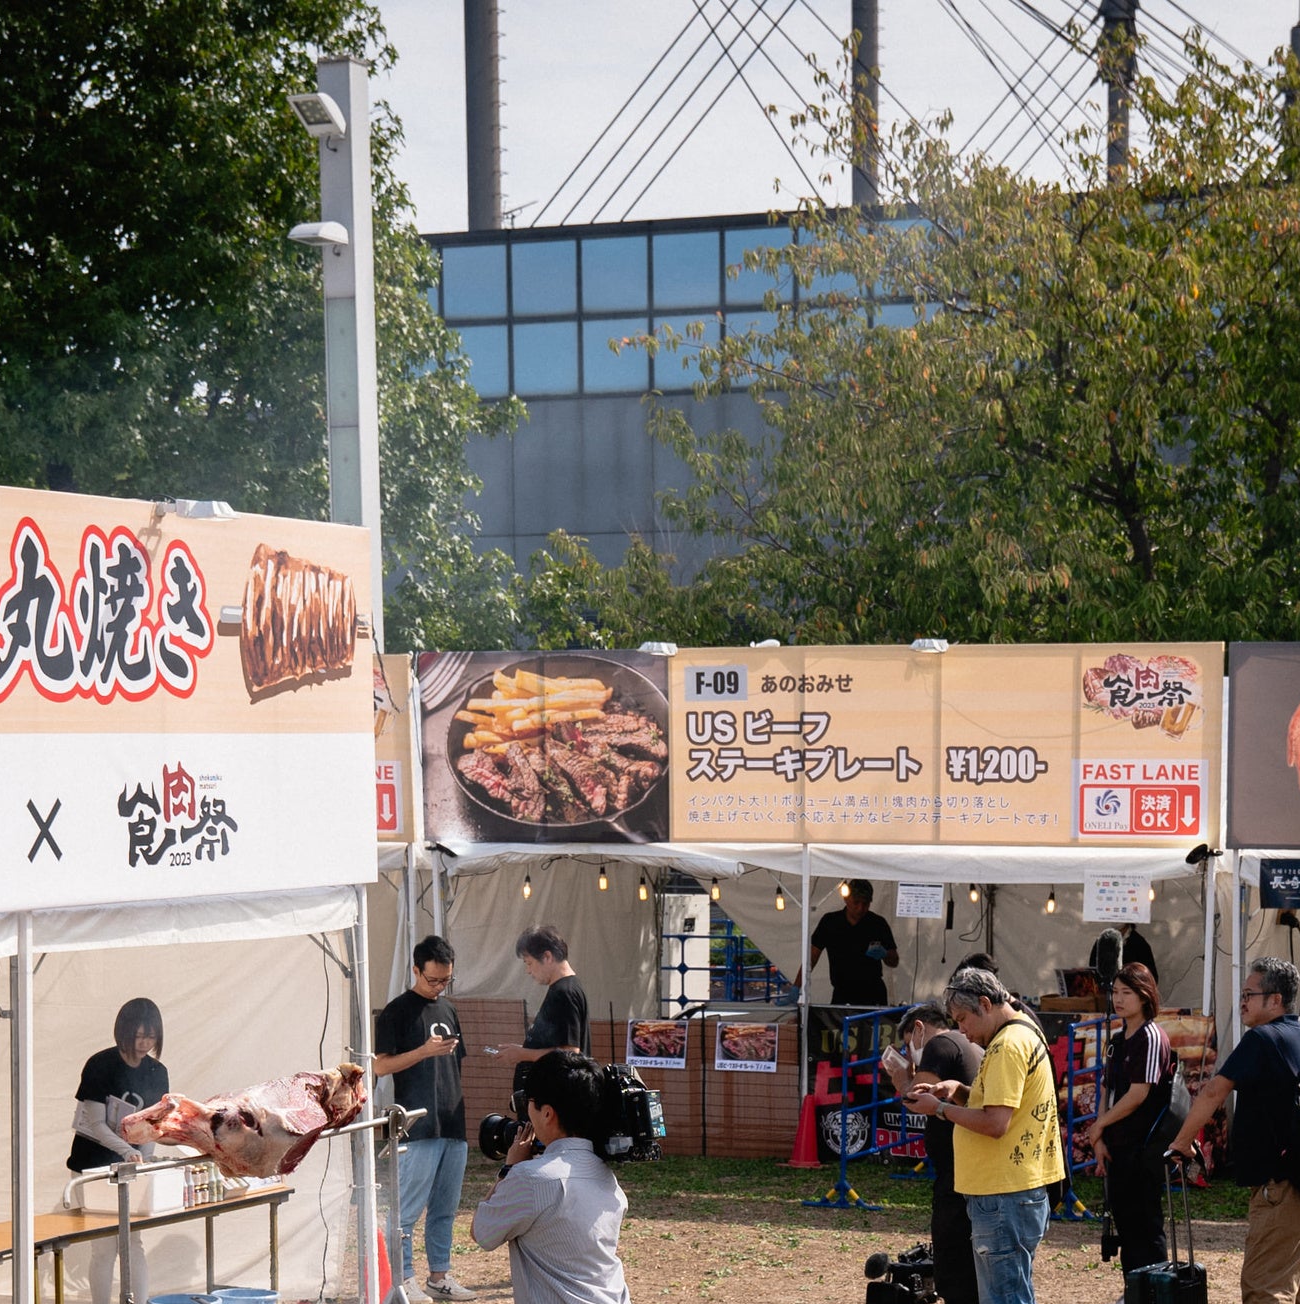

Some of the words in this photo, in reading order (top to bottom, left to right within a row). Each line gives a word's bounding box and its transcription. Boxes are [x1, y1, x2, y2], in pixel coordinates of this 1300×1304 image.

[695, 671, 739, 695] F-09
[761, 674, 853, 694] あのおみせ
[686, 712, 736, 745] US
[744, 709, 831, 745] ビーフ
[687, 747, 921, 782] ステーキプレート
[1082, 764, 1135, 781] FAST
[1142, 764, 1199, 781] LANE
[1140, 794, 1172, 812] 決済
[1114, 822, 1128, 831] Pay
[1140, 812, 1170, 828] OK
[169, 852, 192, 866] 2023
[820, 1026, 859, 1055] US
